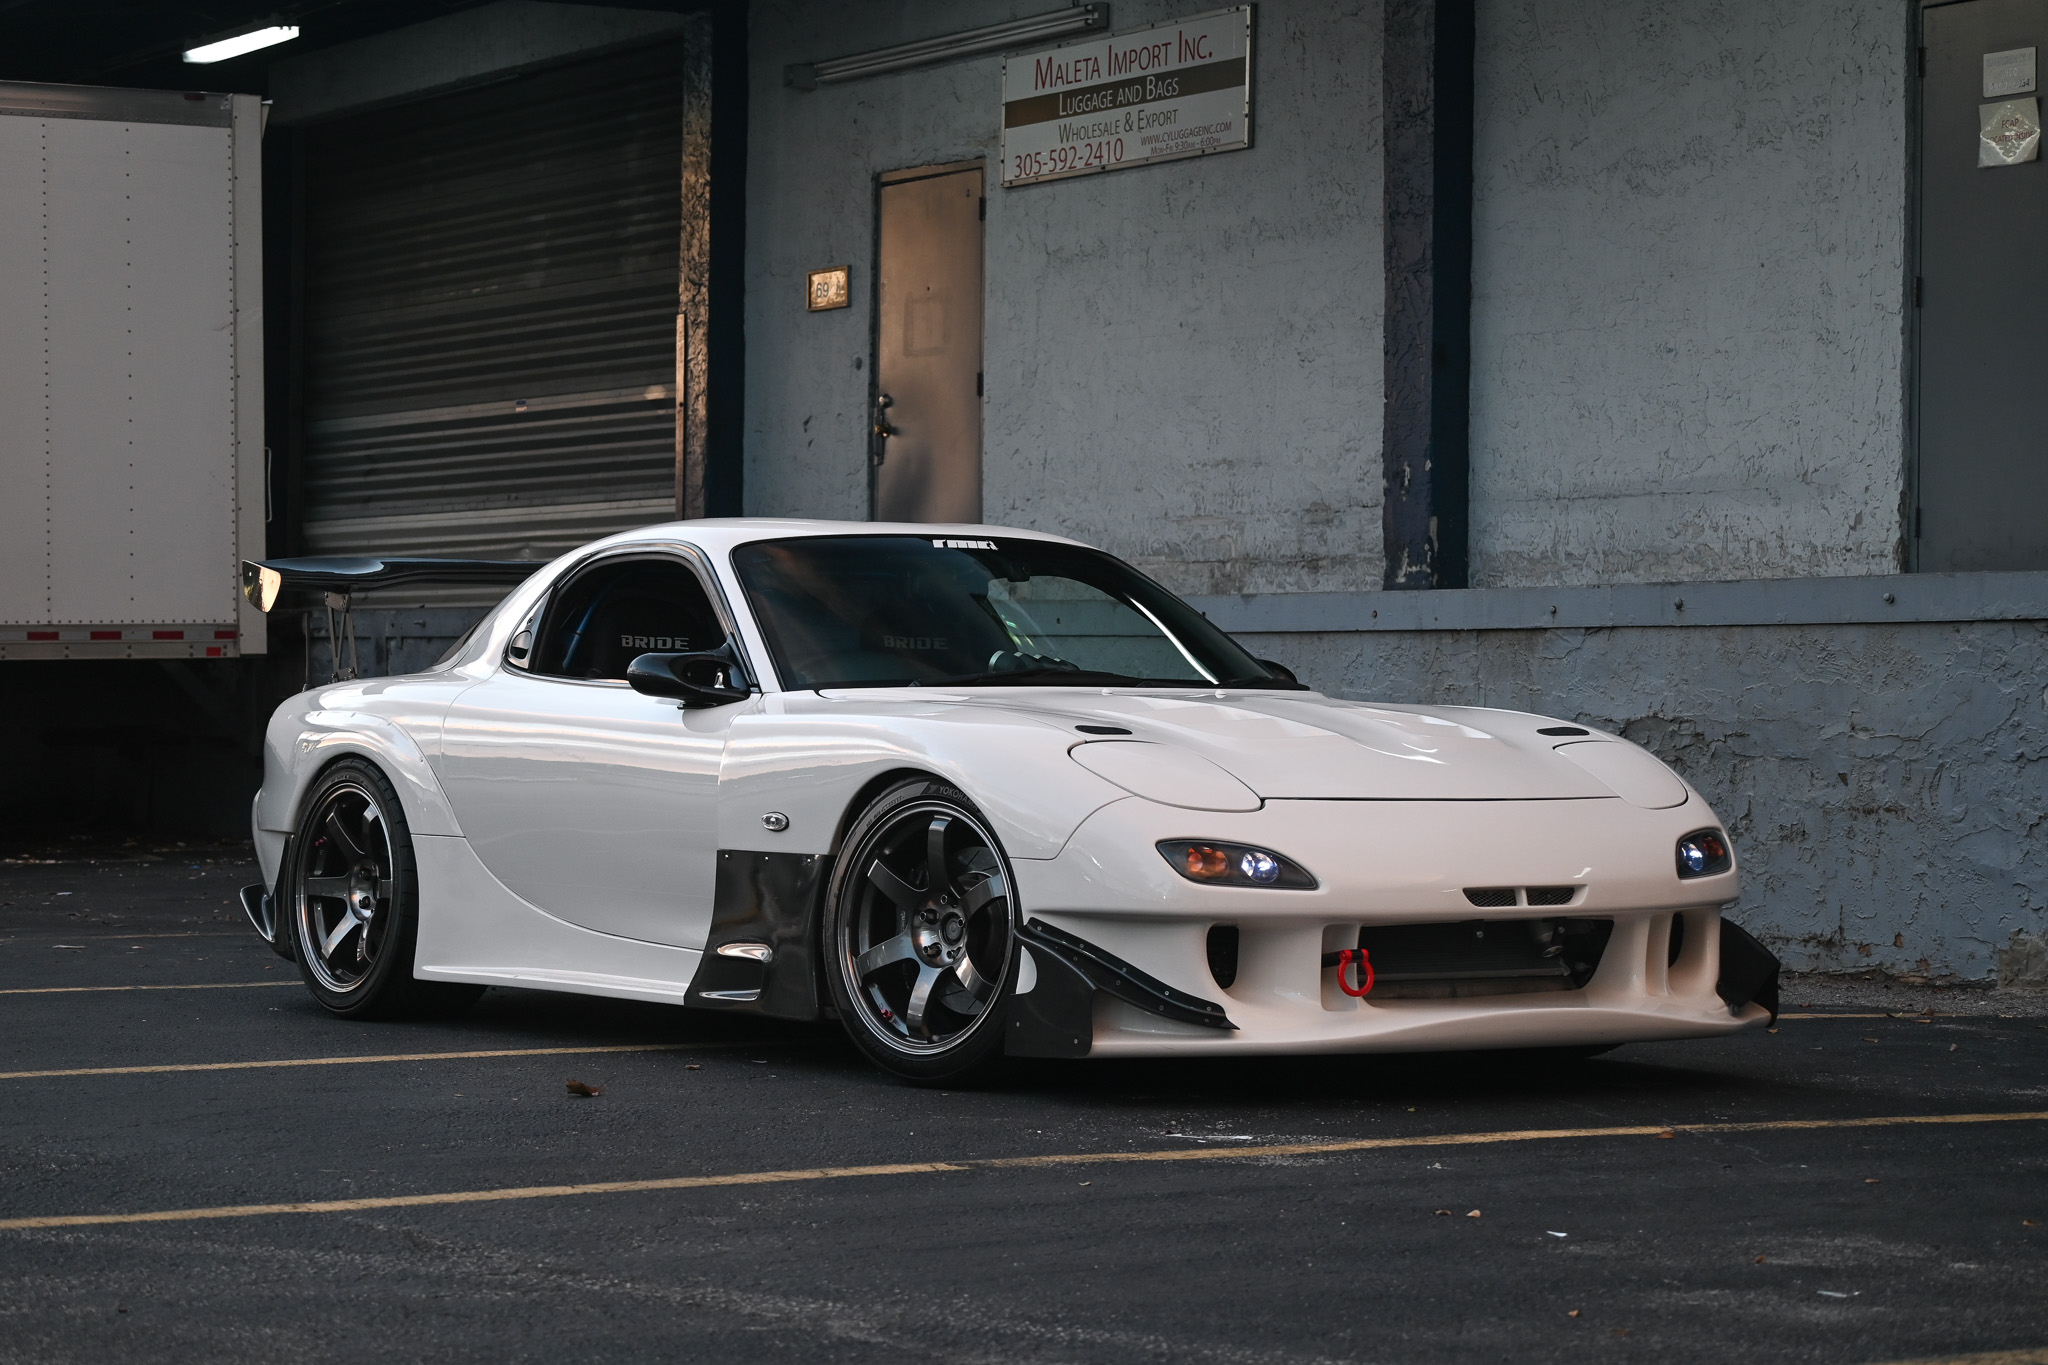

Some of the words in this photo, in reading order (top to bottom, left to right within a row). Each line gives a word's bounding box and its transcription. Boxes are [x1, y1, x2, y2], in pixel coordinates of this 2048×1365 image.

[1034, 56, 1101, 91] MALETA
[1107, 41, 1172, 77] IMPORT
[1178, 30, 1213, 64] INC.
[1058, 90, 1113, 116] LUGGAGE
[1116, 85, 1142, 105] AND
[1146, 76, 1179, 100] BAGS
[1058, 120, 1121, 144] WHOLESALE
[1123, 111, 1134, 133] &
[1137, 109, 1179, 130] EXPORT
[1014, 138, 1124, 178] 305-592-2410
[621, 634, 690, 650] BRIDE
[882, 635, 949, 650] BRIDE
[938, 785, 978, 811] YOKOHAMA
